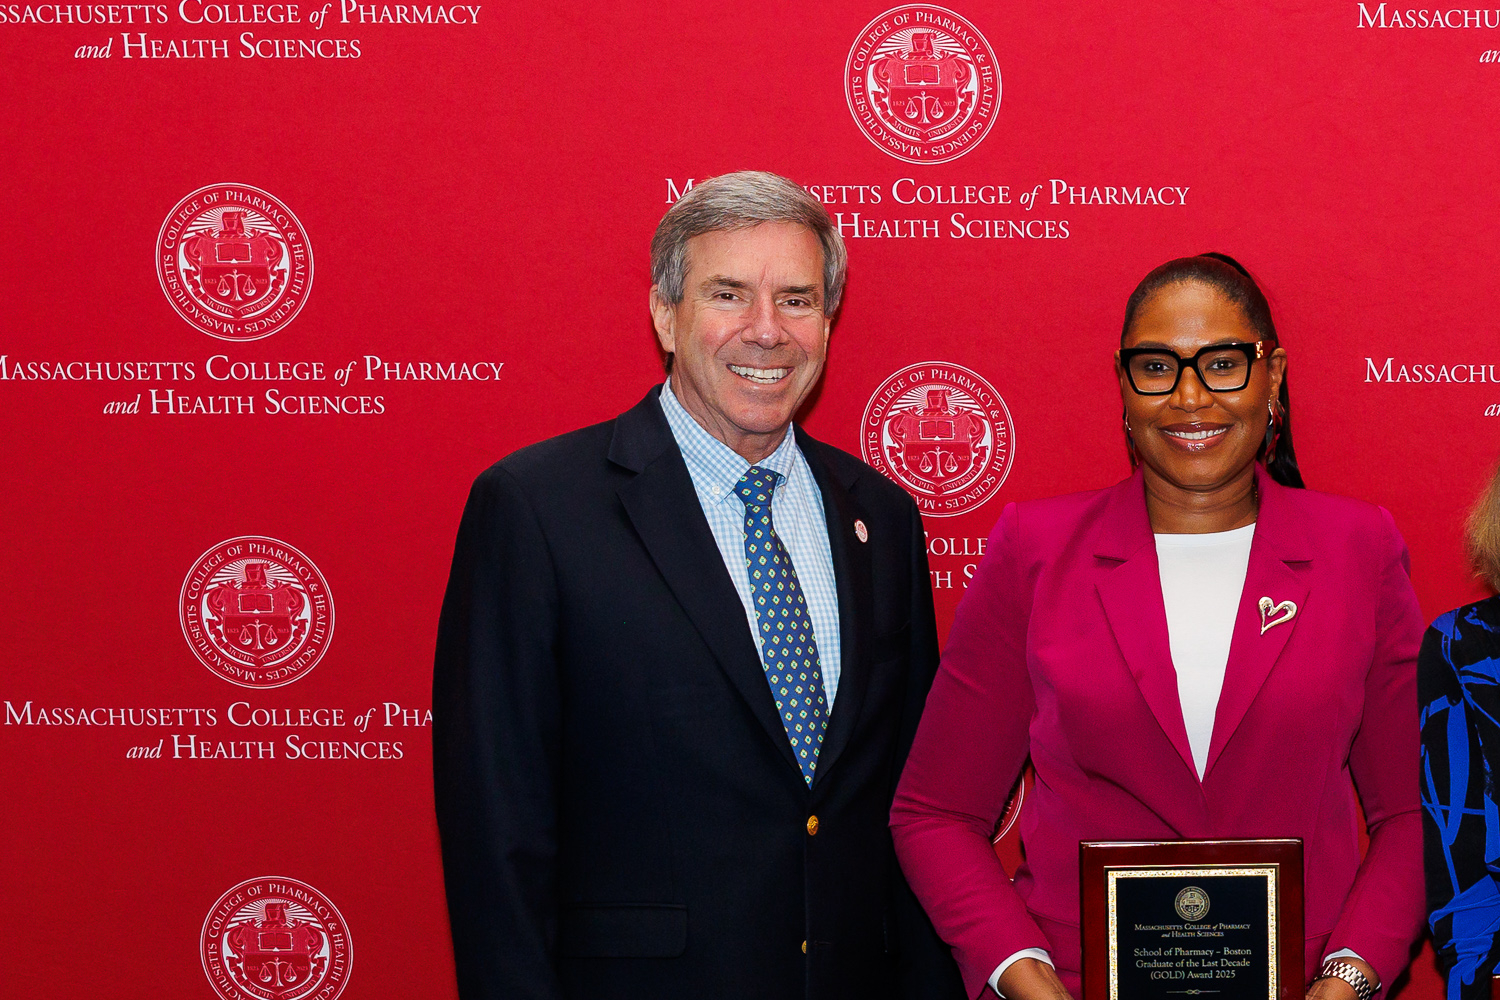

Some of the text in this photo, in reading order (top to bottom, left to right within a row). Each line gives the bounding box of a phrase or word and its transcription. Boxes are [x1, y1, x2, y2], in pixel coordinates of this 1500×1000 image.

[179, 0, 481, 31] COLLEGE of PHARMACY
[75, 32, 361, 58] and HEALTH SCIENCES
[852, 11, 993, 157] MASSACHUSETTS COLLEGE OF PHARMACY & HEALTH SCIENCES
[892, 178, 1190, 210] COLLEGE of PHARMACY
[834, 213, 1069, 239] HEALTH SCIENCES
[206, 355, 326, 380] COLLEGE
[334, 360, 356, 386] of
[364, 356, 504, 380] PHARMACY
[103, 389, 385, 414] and HEALTH SCIENCES
[1219, 922, 1251, 930] PHARMACY
[1134, 947, 1162, 957] School
[1163, 947, 1173, 956] of
[1174, 947, 1214, 957] Pharmacy
[1223, 946, 1252, 955] Boston
[1135, 958, 1251, 969] Graduate of the Last Decade
[1150, 970, 1236, 980] (GOLD) Award 2025
